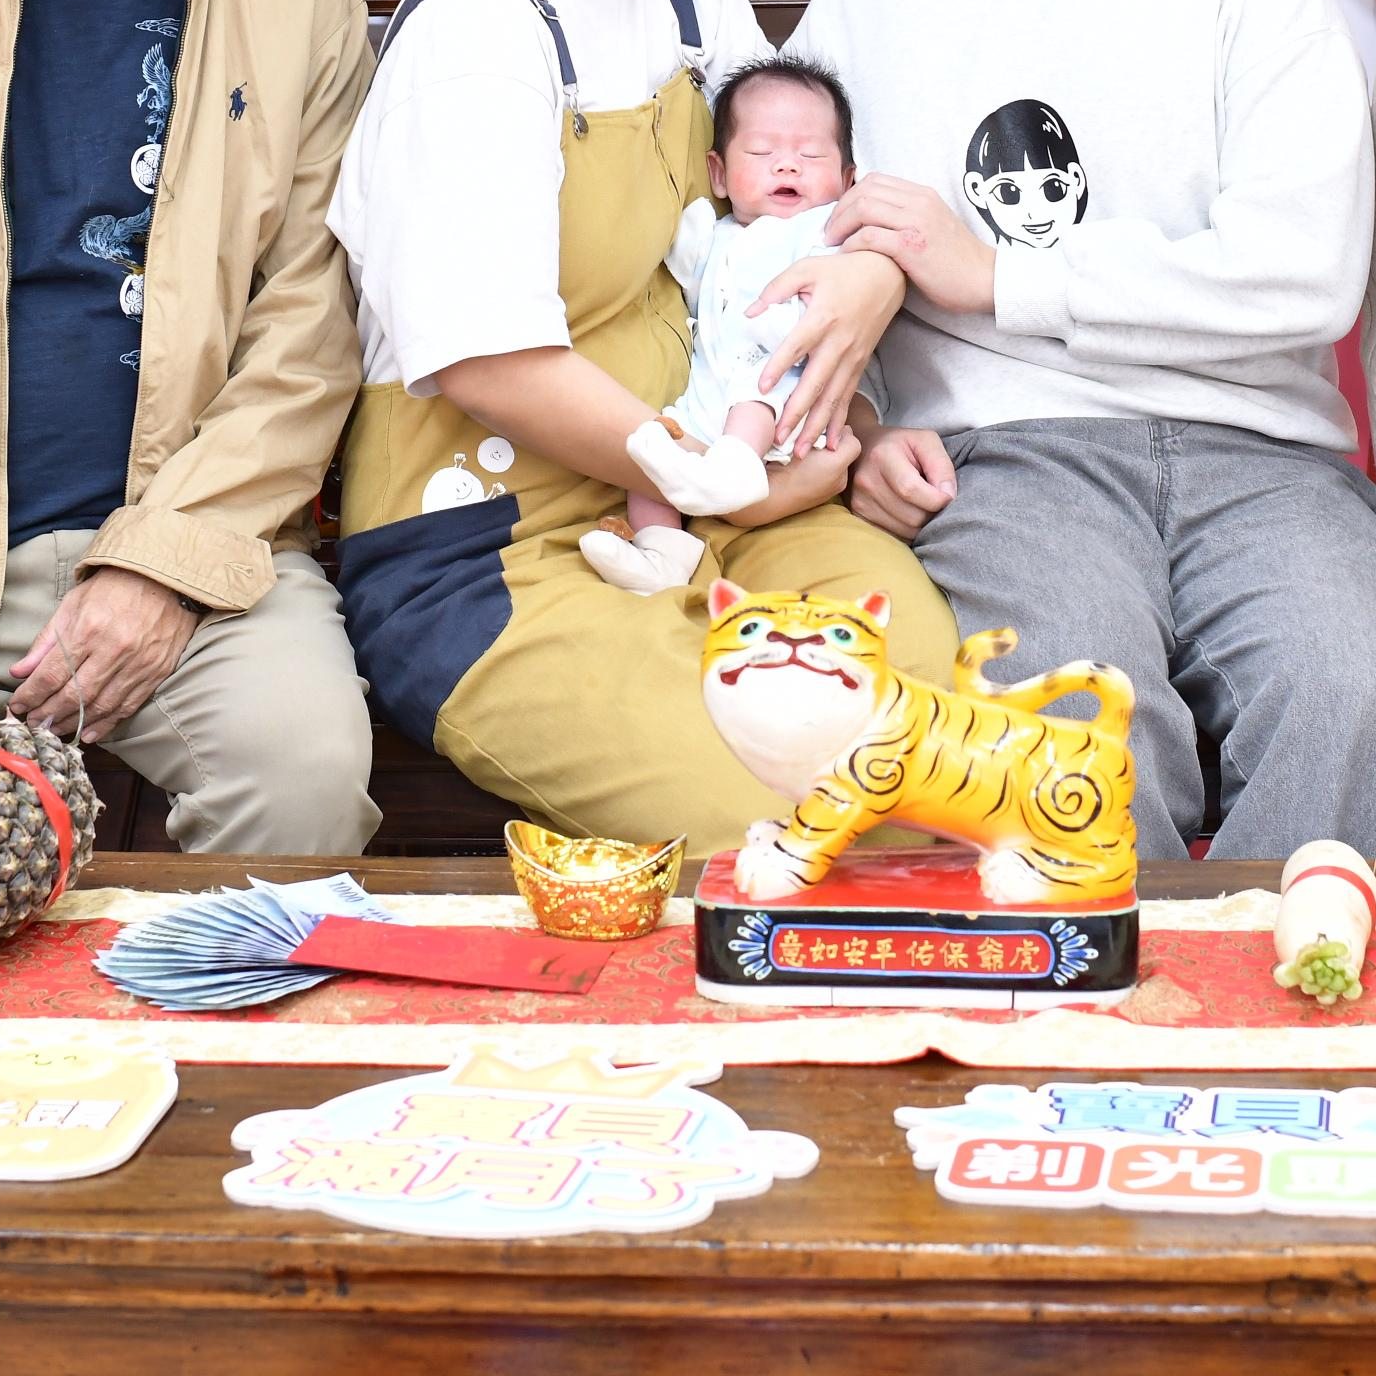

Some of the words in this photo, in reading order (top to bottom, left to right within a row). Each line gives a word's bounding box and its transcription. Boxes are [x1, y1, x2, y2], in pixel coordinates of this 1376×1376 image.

[327, 881, 365, 903] 1000
[375, 1093, 694, 1156] 寶貝
[1040, 1087, 1345, 1142] 寶貝
[250, 1137, 742, 1211] 滿月了
